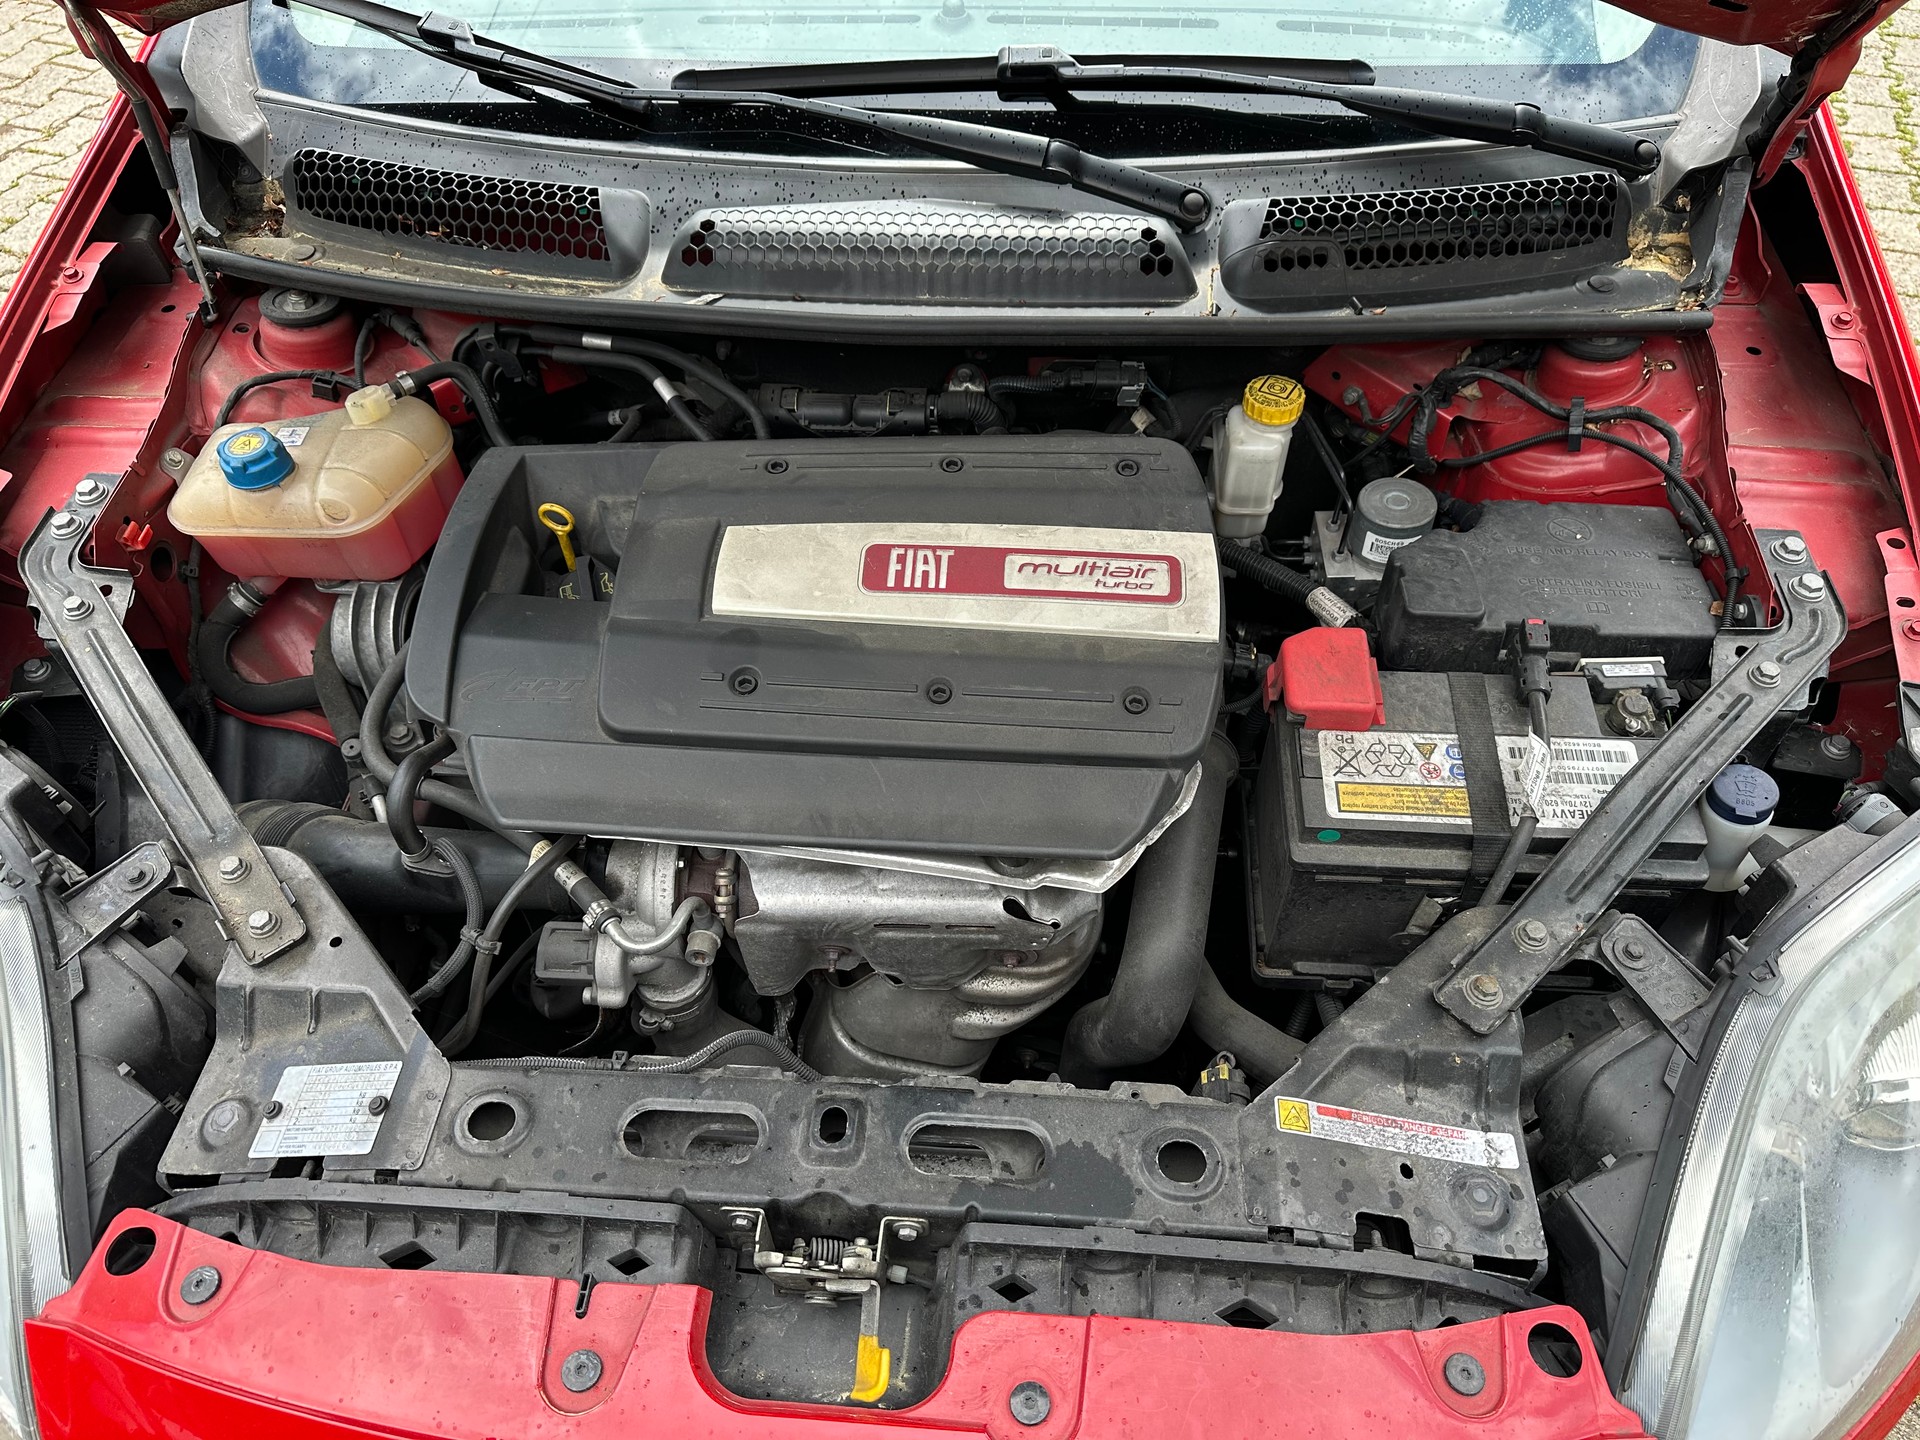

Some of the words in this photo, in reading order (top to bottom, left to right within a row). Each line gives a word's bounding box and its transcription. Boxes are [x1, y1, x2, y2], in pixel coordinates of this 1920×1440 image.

[1374, 538, 1396, 546] BOSCH
[1506, 546, 1542, 555] FUSE
[1549, 546, 1573, 556] AND
[1581, 547, 1618, 557] RELAY
[1624, 550, 1652, 559] BOX
[886, 547, 955, 589] FIAT
[1016, 560, 1157, 580] multiair
[1094, 578, 1154, 590] turbo
[1518, 577, 1602, 588] CENTRALINA
[1606, 580, 1662, 590] FUSIBILI
[1550, 586, 1642, 598] TELERUTTORI
[1336, 734, 1354, 745] Pb
